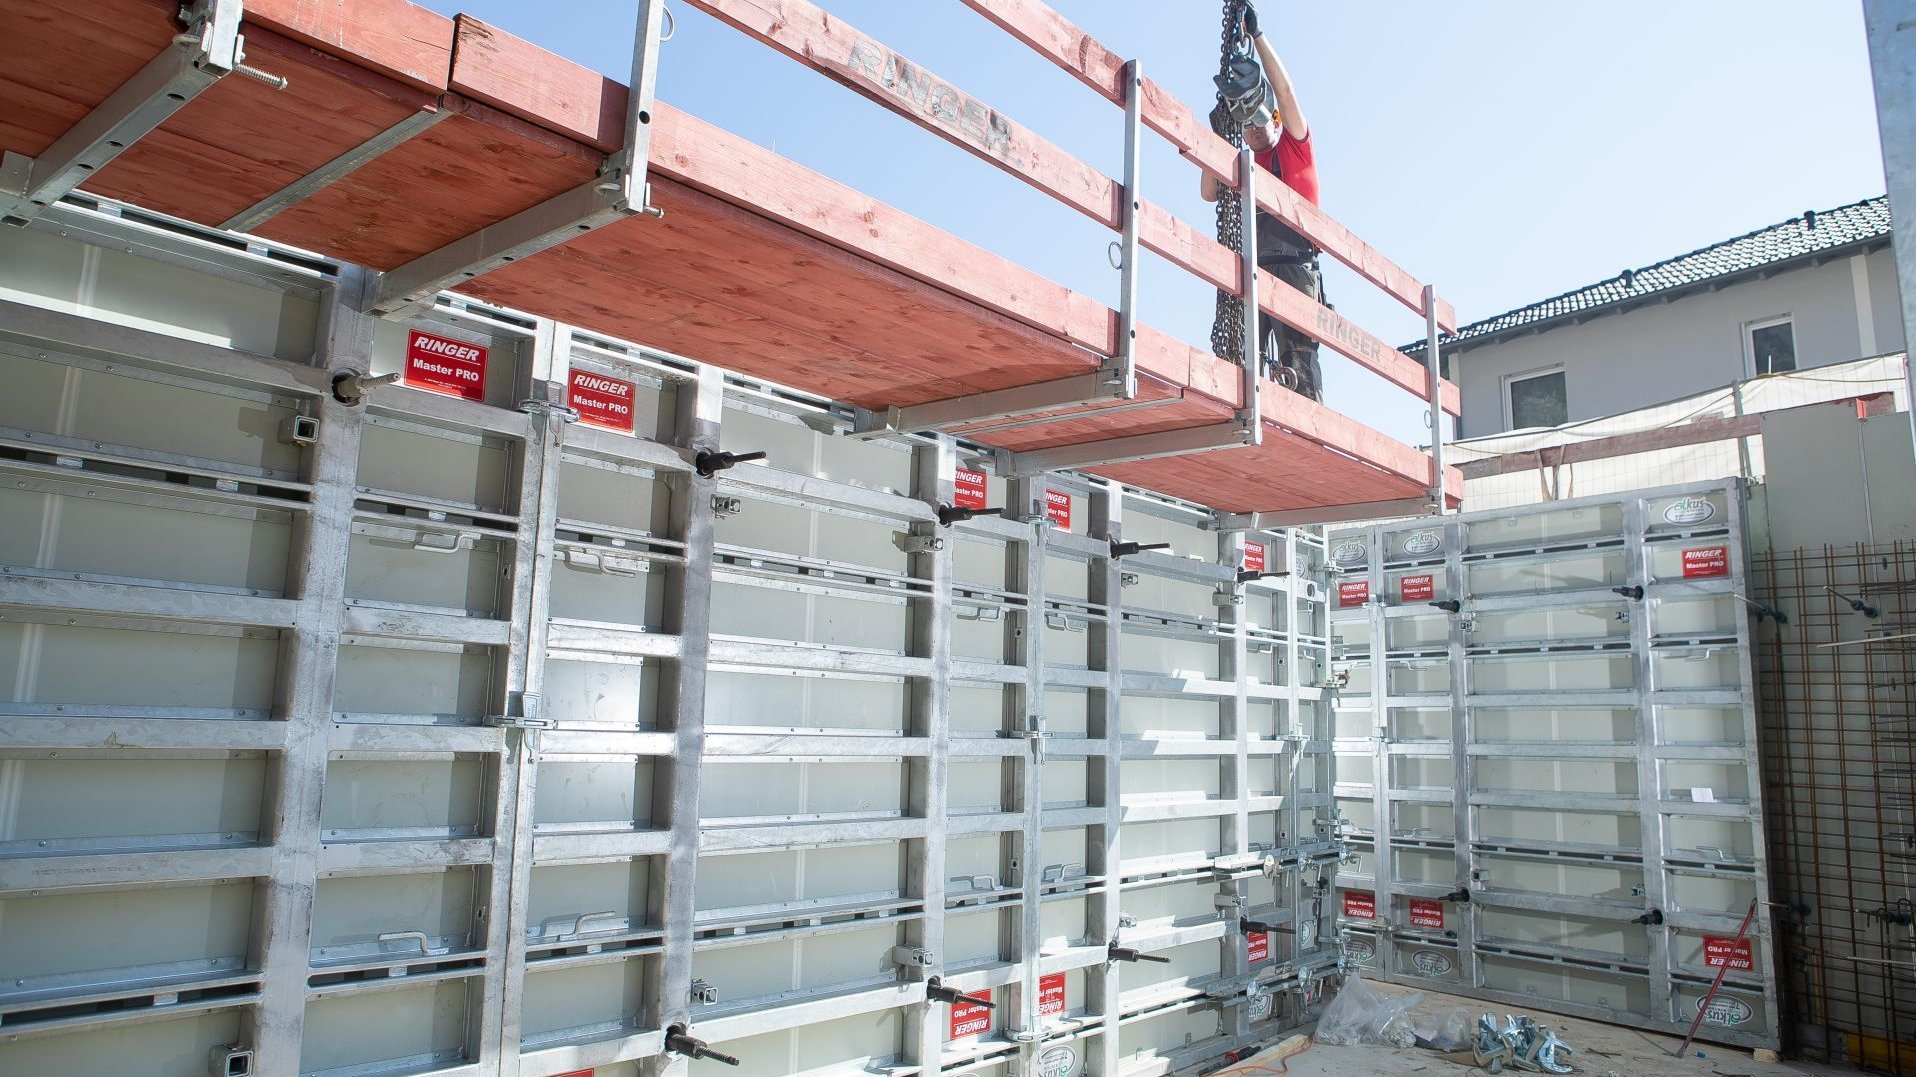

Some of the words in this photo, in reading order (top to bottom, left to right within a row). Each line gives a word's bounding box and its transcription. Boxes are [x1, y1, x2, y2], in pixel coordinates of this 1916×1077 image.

[848, 39, 1013, 152] RINGER
[1316, 307, 1381, 361] RINGER
[414, 336, 480, 361] RINGER
[413, 358, 453, 375] Master
[455, 368, 480, 381] PRO
[573, 374, 629, 396] RINGER
[573, 394, 607, 410] Master
[608, 402, 629, 415] PRO
[954, 486, 971, 496] aster
[971, 490, 984, 498] PRO
[1045, 492, 1068, 505] INGER
[1674, 497, 1704, 511] alkus
[1057, 509, 1068, 518] PRO
[1685, 549, 1721, 559] RINGER
[1348, 908, 1374, 917] RINGER
[1413, 917, 1441, 927] RINGER
[1710, 957, 1750, 968] RINER
[954, 1007, 967, 1018] PRO
[1039, 1000, 1063, 1013] RINGE
[1707, 1010, 1741, 1026] alkus
[955, 1018, 988, 1035] RINGER
